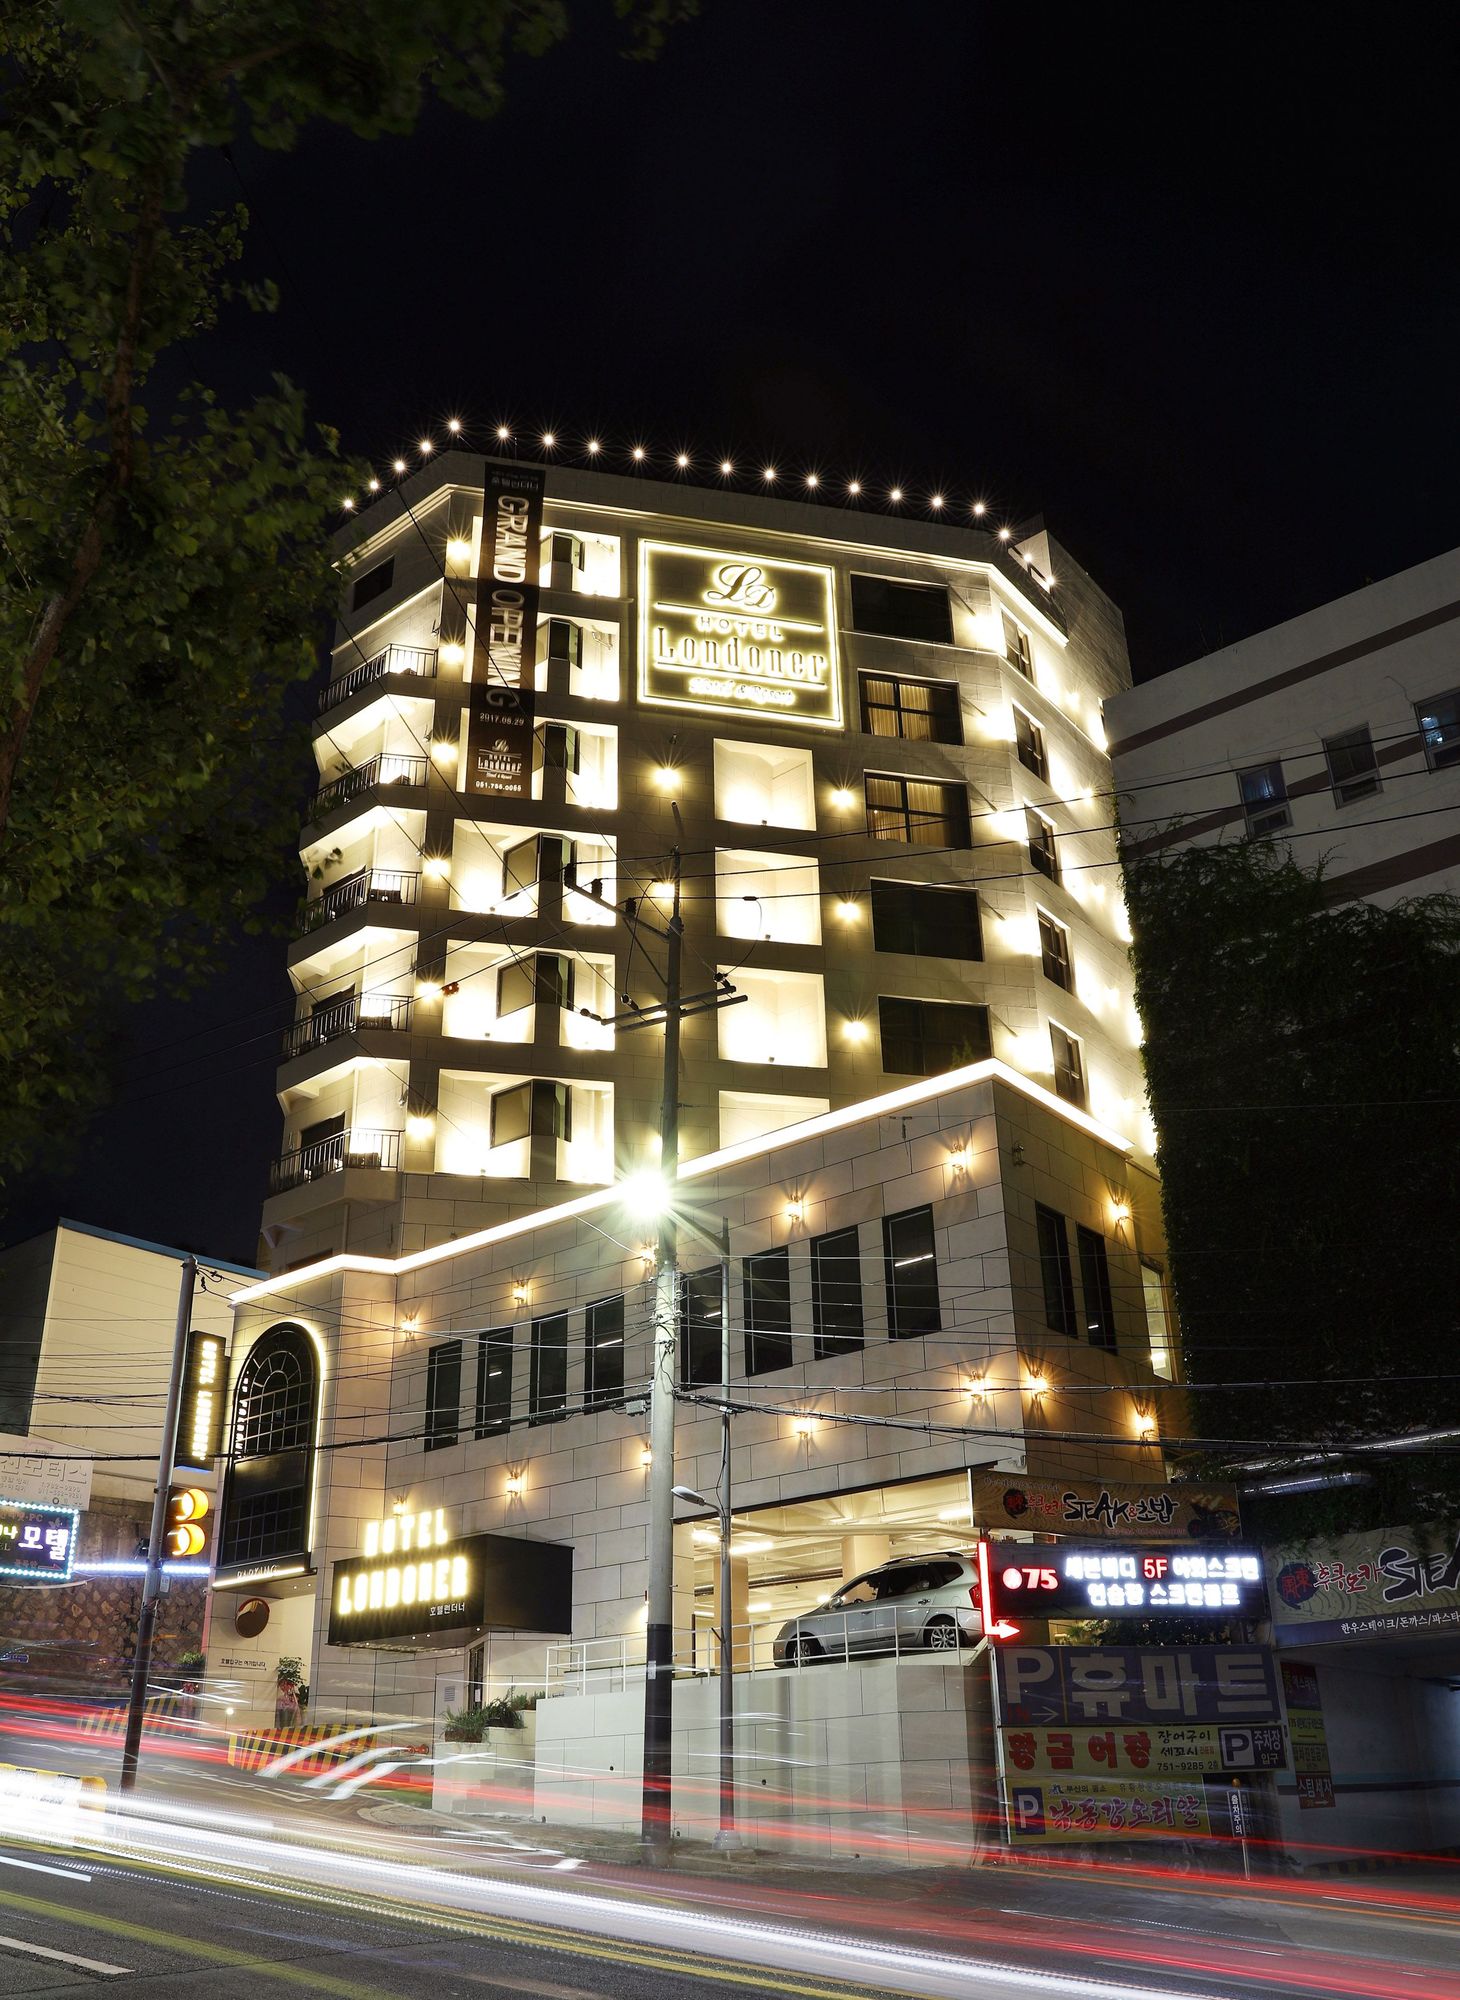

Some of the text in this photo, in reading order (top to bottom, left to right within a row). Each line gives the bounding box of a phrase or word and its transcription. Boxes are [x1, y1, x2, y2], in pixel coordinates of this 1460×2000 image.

[493, 495, 530, 584] GRAND
[701, 616, 782, 638] HOTEL
[486, 589, 524, 708] OPENING
[658, 627, 824, 678] Londoner
[18, 1526, 69, 1561] 모텔
[364, 1508, 449, 1557] HOTEL
[1143, 1558, 1168, 1579] 5F
[1003, 1649, 1054, 1704] P
[1069, 1652, 1274, 1718] 휴마트
[1157, 1729, 1212, 1744] 장어구이
[1224, 1733, 1250, 1762] P
[1254, 1730, 1282, 1751] 주차장
[1157, 1761, 1205, 1772] 751-9285
[1260, 1753, 1280, 1765] 입구
[1018, 1794, 1039, 1829] P
